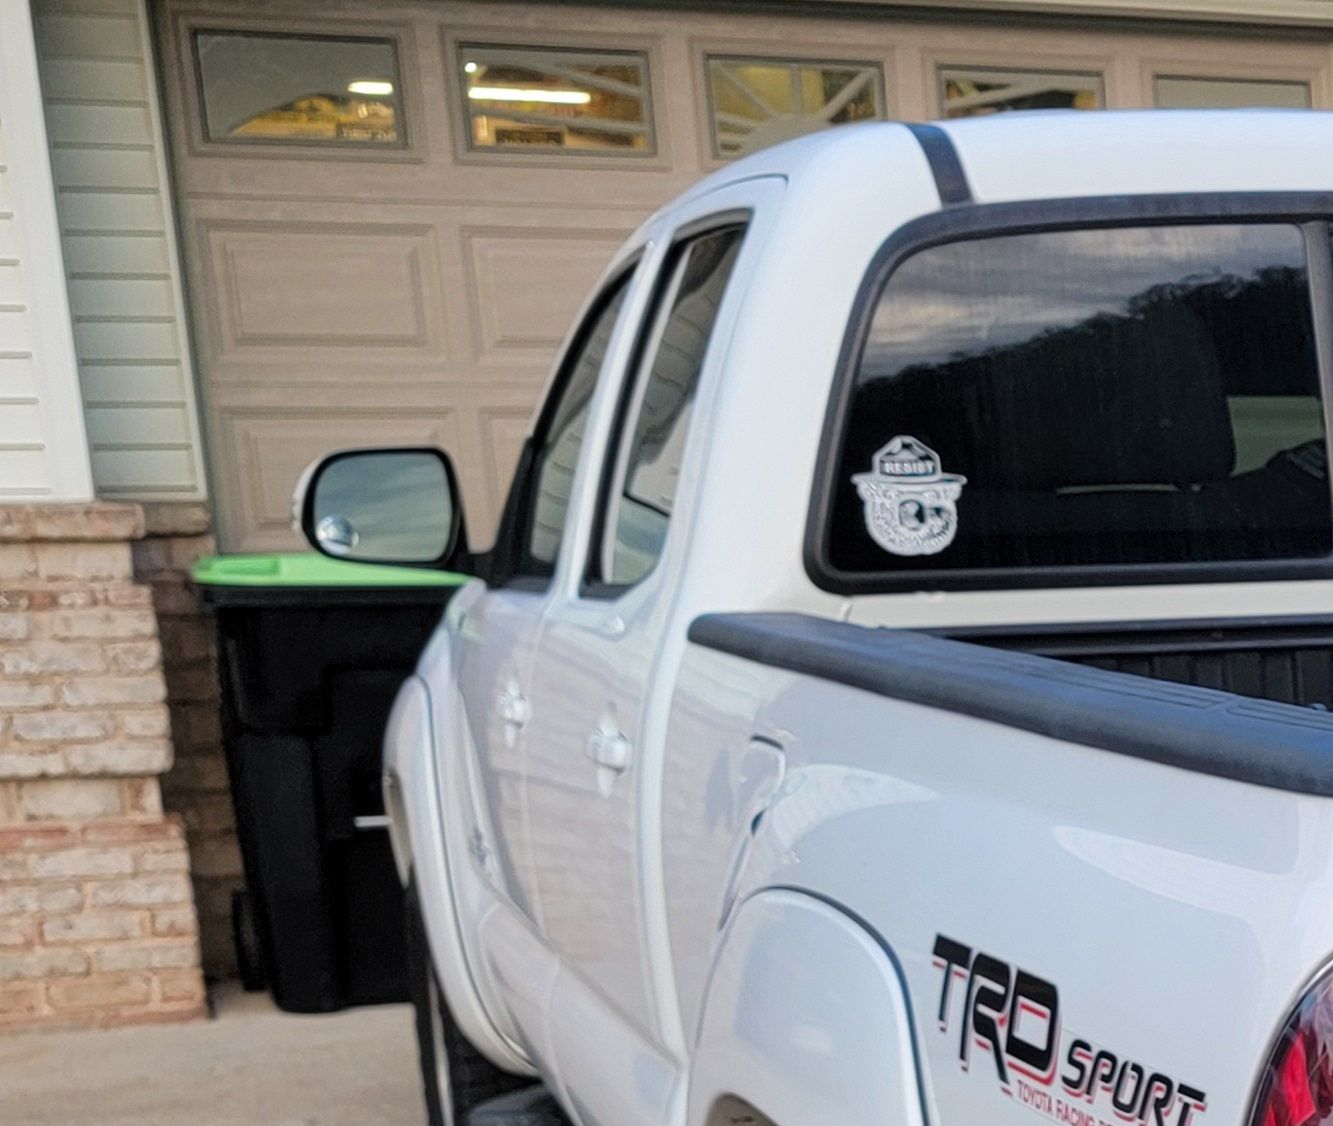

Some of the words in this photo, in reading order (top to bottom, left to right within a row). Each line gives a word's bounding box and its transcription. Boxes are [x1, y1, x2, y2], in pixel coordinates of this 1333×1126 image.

[883, 461, 935, 474] RESIST
[932, 932, 1062, 1096] TRD
[1017, 1079, 1054, 1114] TOYOTA
